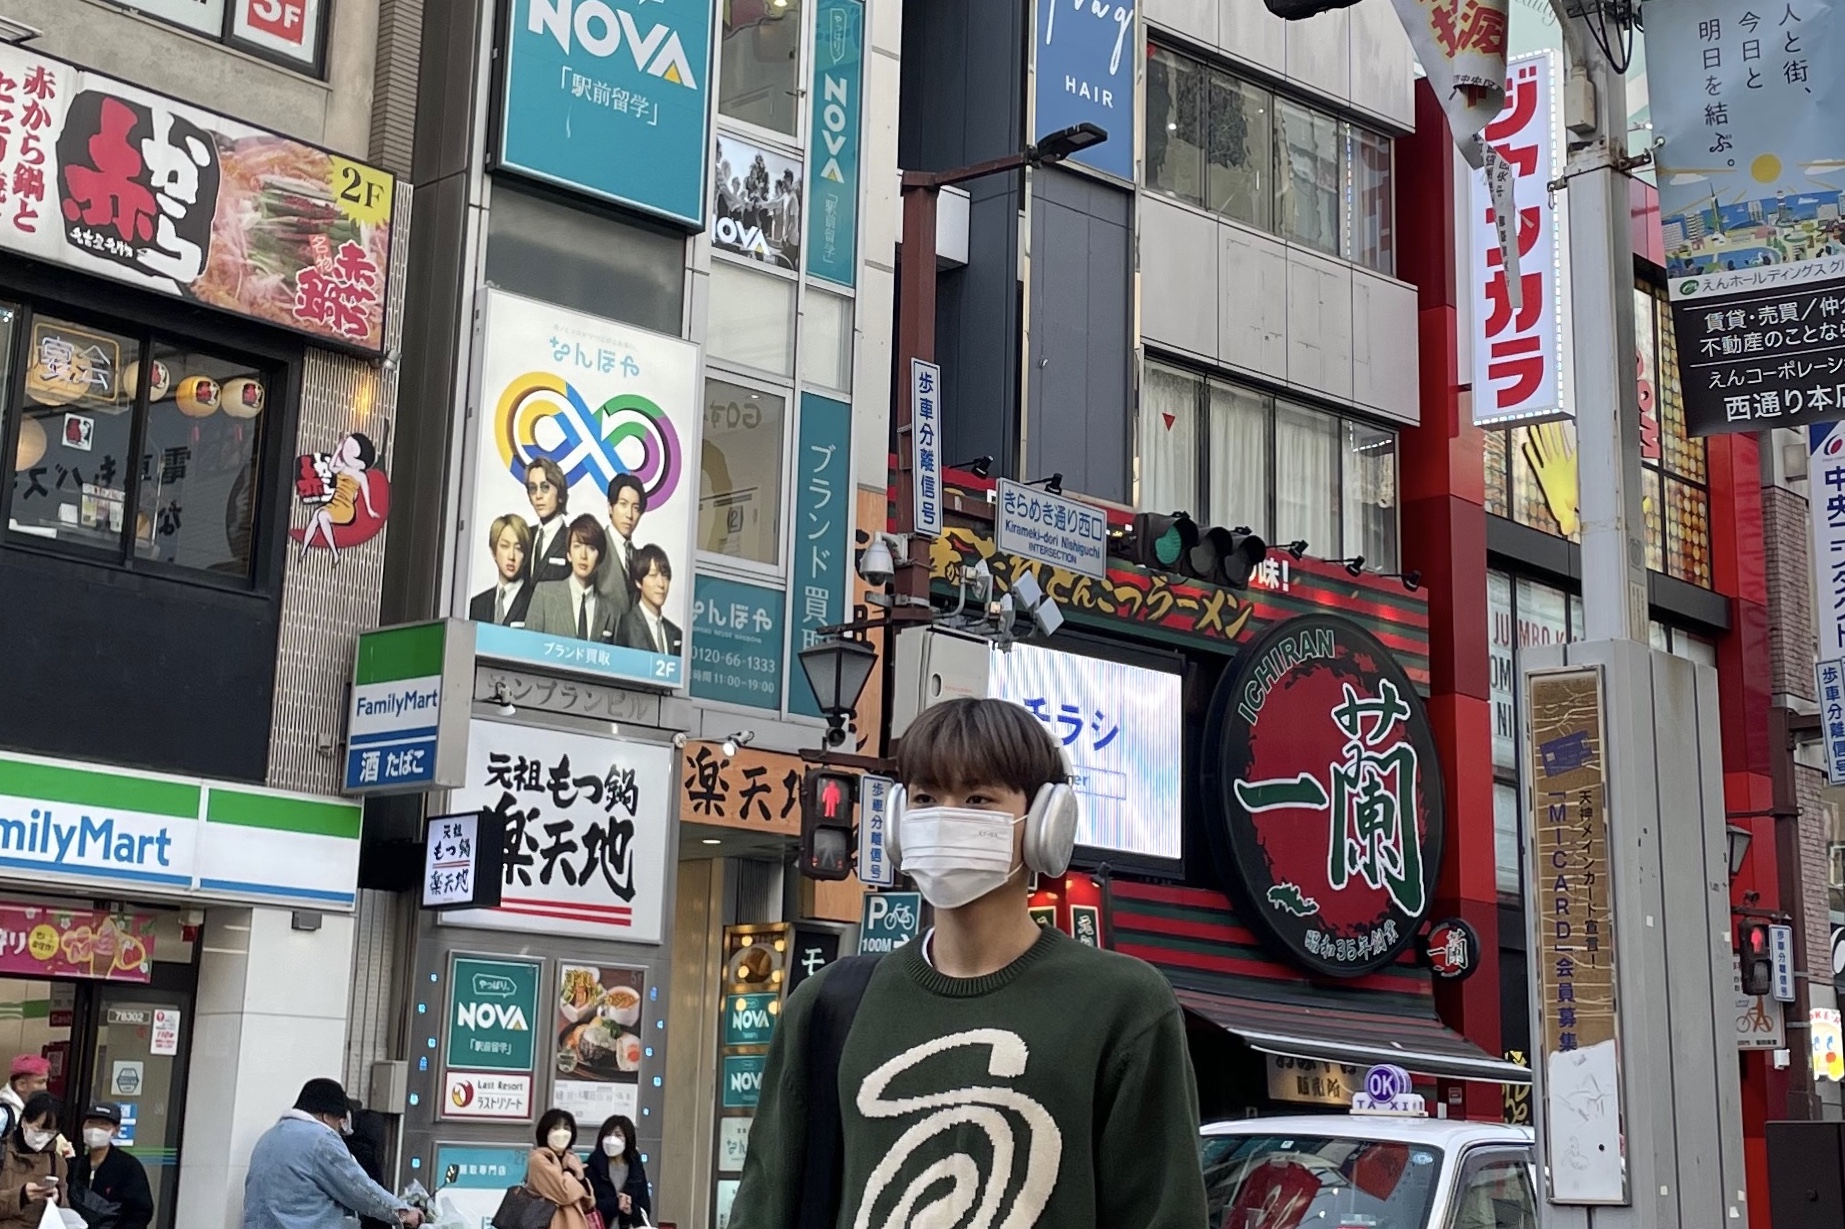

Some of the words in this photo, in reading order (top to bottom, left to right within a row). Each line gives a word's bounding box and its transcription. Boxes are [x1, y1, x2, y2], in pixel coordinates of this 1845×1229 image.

[527, 0, 698, 90] NOVA
[1738, 11, 1763, 89] 今日と
[1778, 3, 1812, 94] 人と街、
[1065, 75, 1114, 109] HAIR
[1699, 19, 1735, 167] 明日を結ぶ。
[820, 73, 848, 184] NOVA
[12, 65, 56, 233] 赤から鍋と
[340, 167, 385, 209] 2F
[711, 214, 771, 256] OVA
[1702, 263, 1827, 293] えんホールディングス
[1708, 357, 1845, 390] えんコーポレーシ
[918, 371, 937, 525] 歩車分離信号
[1003, 488, 1103, 542] きらめき通り西口
[1005, 519, 1059, 547] Kirameki-dori
[1061, 536, 1101, 559] Nishiguchi
[1028, 542, 1077, 565] INTERSECTION
[543, 642, 611, 666] ブランド買取
[655, 660, 676, 678] 2F
[1237, 628, 1336, 726] ICHIRAN
[357, 688, 438, 717] FamilyMart
[359, 751, 381, 782] 酒
[385, 748, 425, 777] たばこ
[484, 752, 639, 817] 元祖もつ鍋
[1234, 677, 1425, 918] 一蘭
[483, 792, 637, 903] 楽天地
[870, 782, 884, 879] 歩車分離信号
[434, 838, 471, 861] もつ鍋
[430, 869, 470, 896] 楽天地
[868, 896, 889, 930] P
[862, 937, 893, 953] 100M
[457, 1001, 529, 1032] NOVA
[732, 1009, 770, 1031] NOVA
[477, 1080, 495, 1091] Last
[497, 1082, 524, 1092] Resort
[731, 1071, 763, 1093] NOV
[1369, 1073, 1394, 1096] OK
[477, 1094, 523, 1110] ラストリゾート
